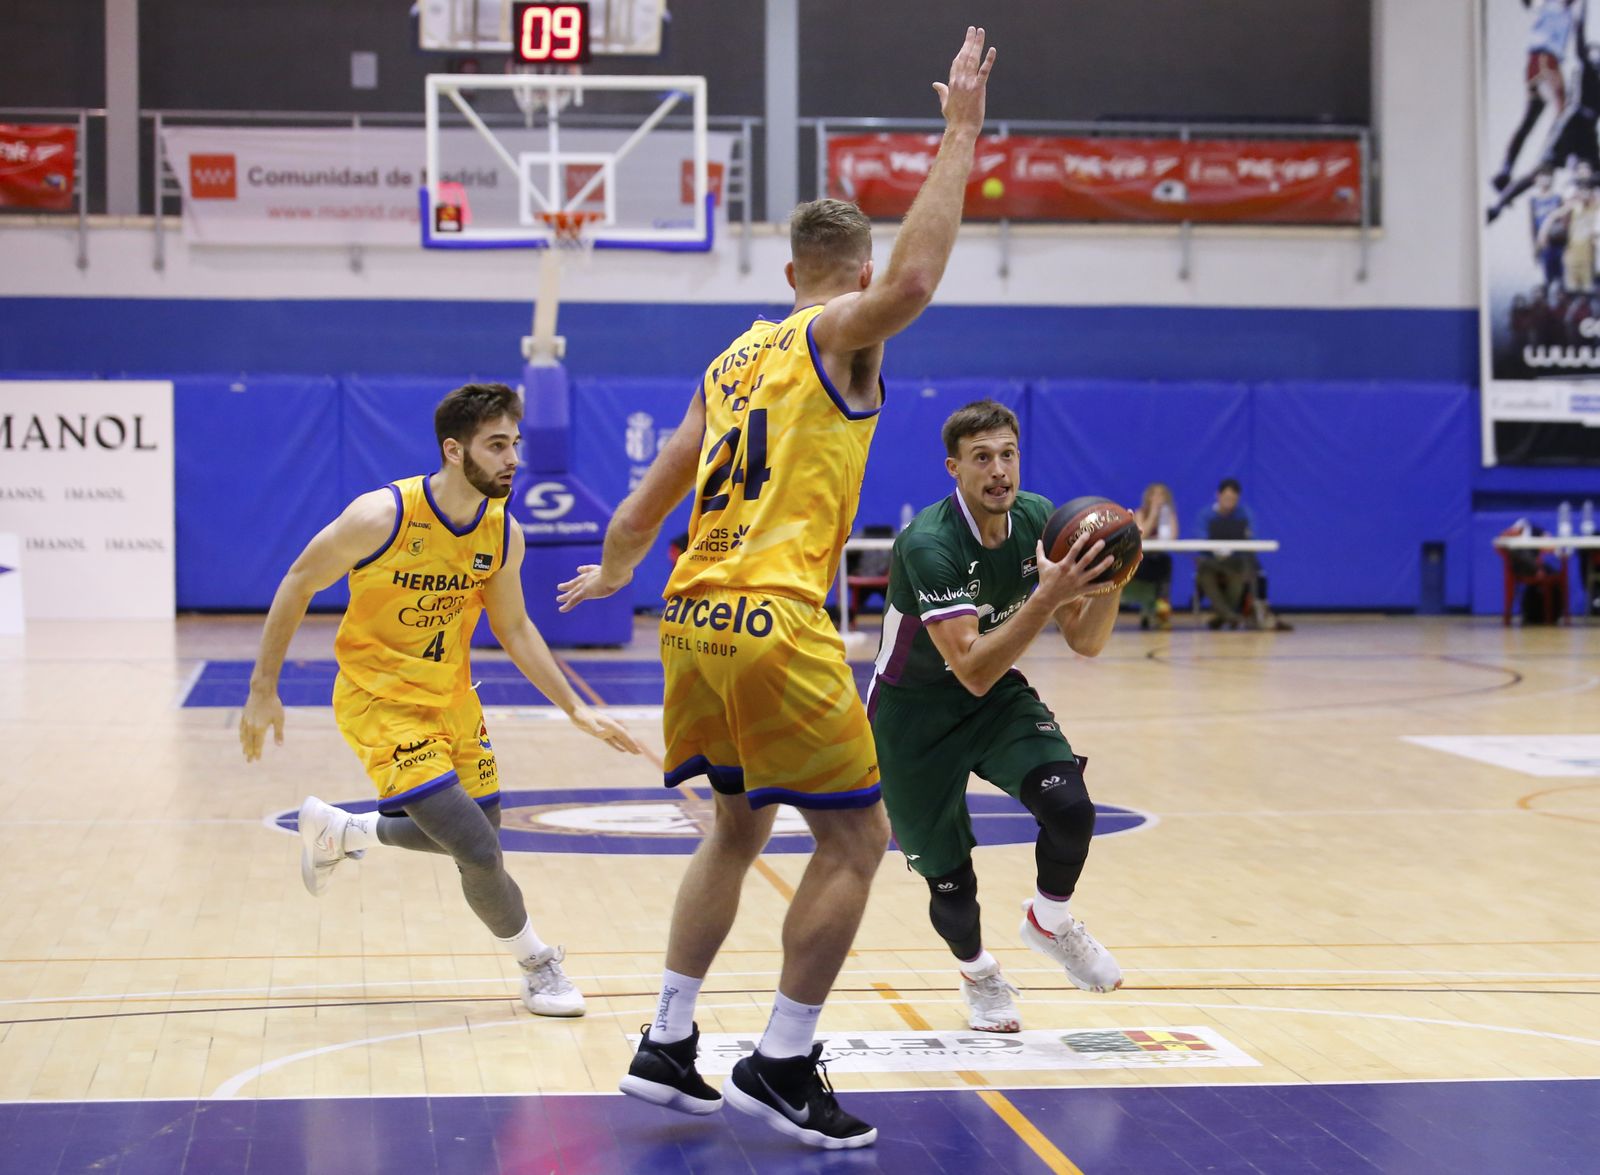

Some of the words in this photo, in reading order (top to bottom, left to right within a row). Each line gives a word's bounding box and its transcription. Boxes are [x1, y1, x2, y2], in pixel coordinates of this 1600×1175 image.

[521, 6, 581, 60] 09
[247, 166, 379, 187] Comunidad
[386, 167, 413, 186] de
[701, 408, 771, 515] 24
[0, 487, 44, 500] ANOL
[26, 537, 86, 550] IMANOL
[664, 594, 773, 638] arceló
[422, 631, 445, 662] 4
[697, 640, 737, 657] GROUP
